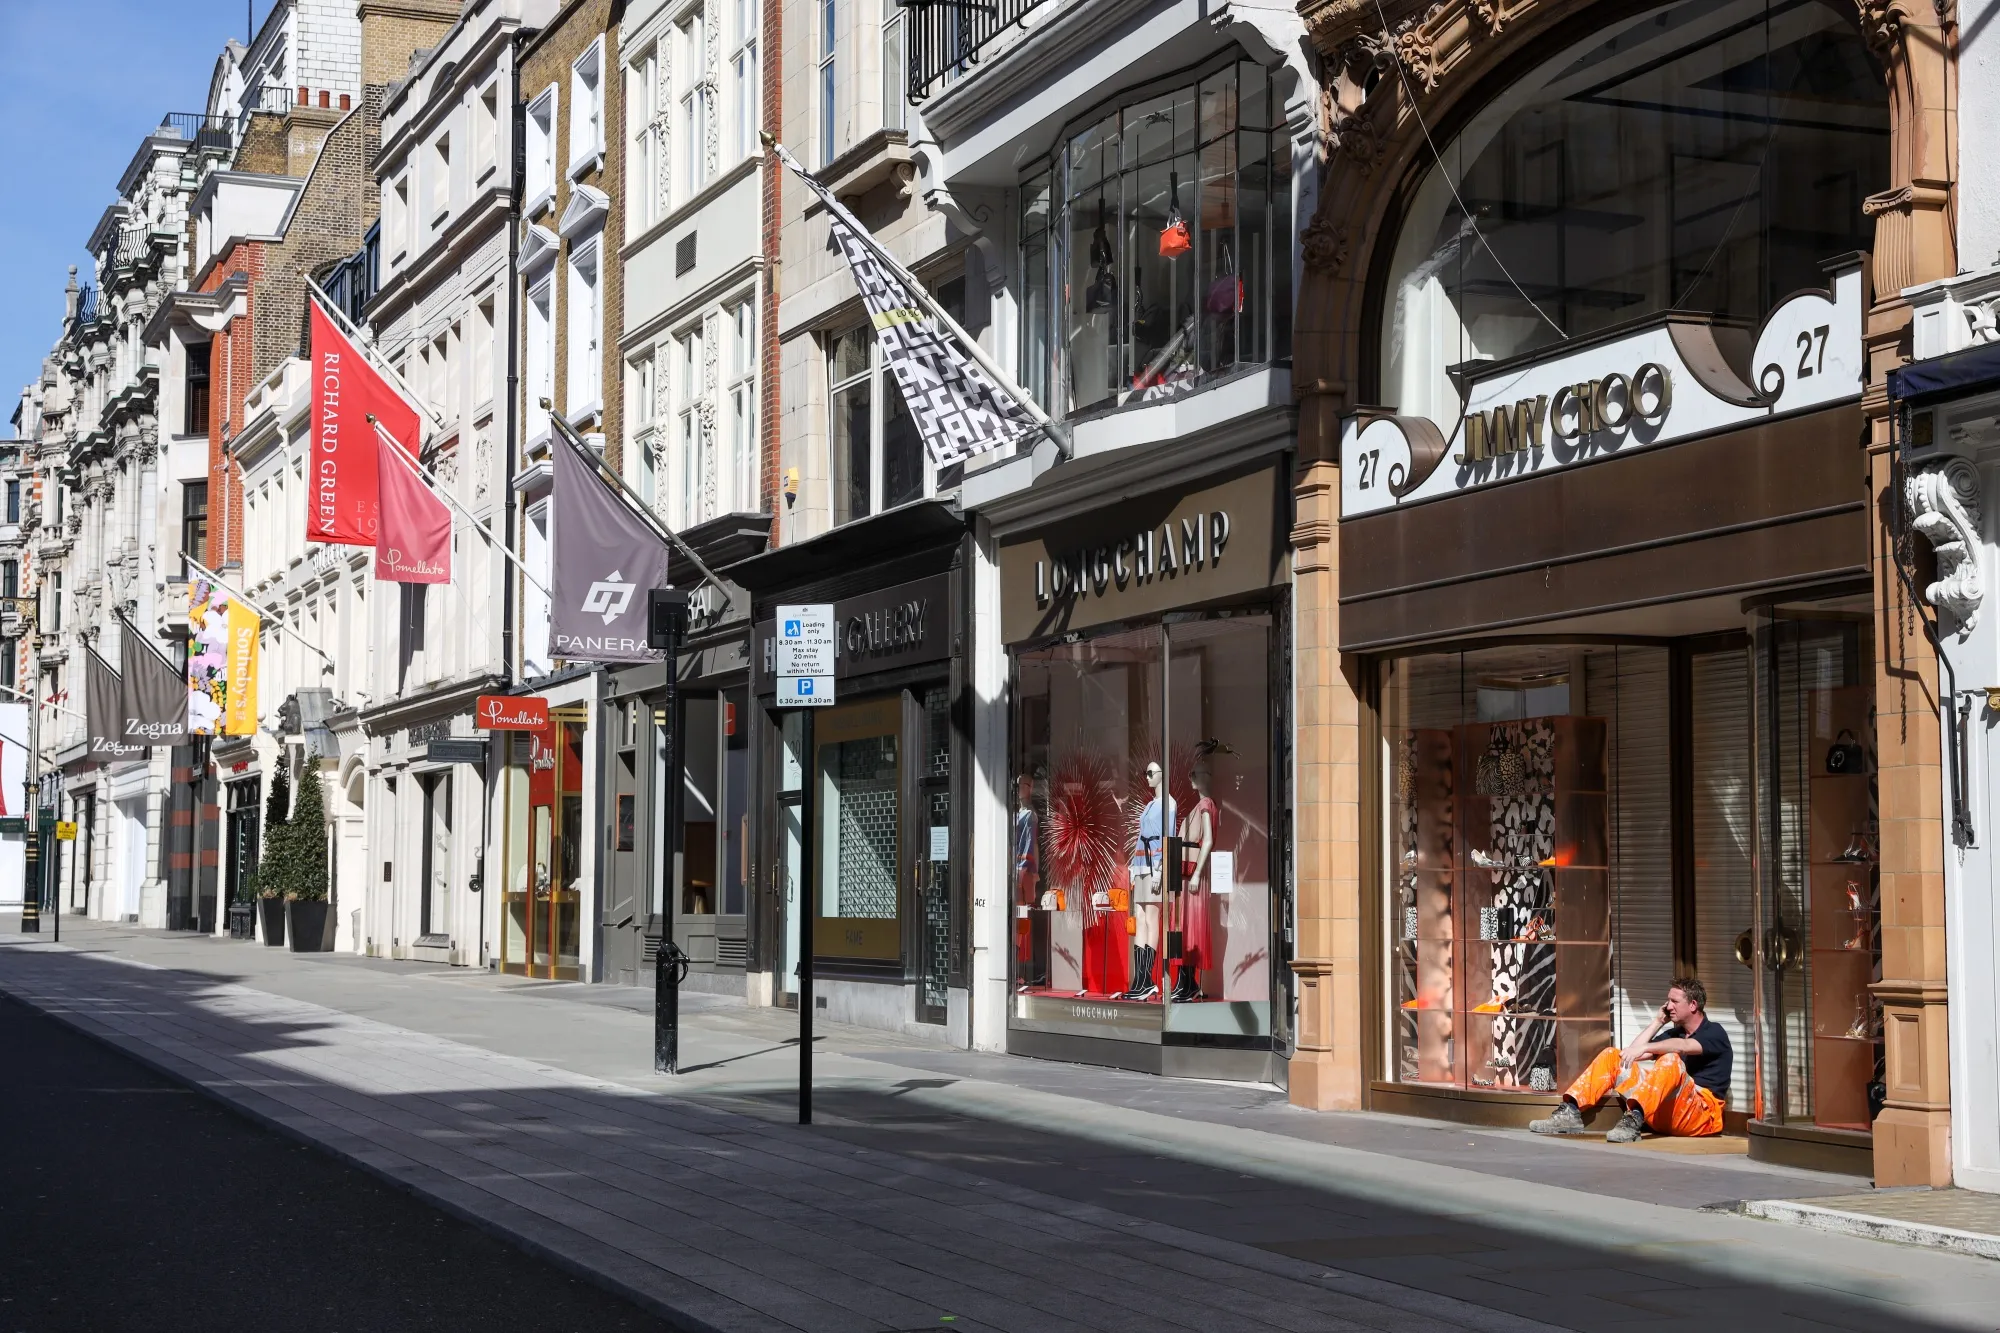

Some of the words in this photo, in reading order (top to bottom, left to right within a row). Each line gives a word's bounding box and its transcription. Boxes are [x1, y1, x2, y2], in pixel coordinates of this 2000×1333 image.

[1797, 324, 1829, 379] 27
[321, 352, 340, 453] RICHARD
[1454, 394, 1548, 465] JIMMY
[1550, 362, 1672, 439] CHOO
[1359, 449, 1379, 490] 27
[320, 460, 336, 533] GREEN
[380, 548, 445, 575] Pomellato
[1036, 511, 1230, 601] LONGCHAMP
[557, 634, 657, 652] PANERA
[846, 599, 927, 654] GALLERY
[232, 627, 253, 708] Sotheby's
[801, 680, 811, 694] P
[125, 718, 184, 740] Zegna
[481, 700, 544, 725] Pomellato
[1072, 1005, 1118, 1020] LONGCHAMP
